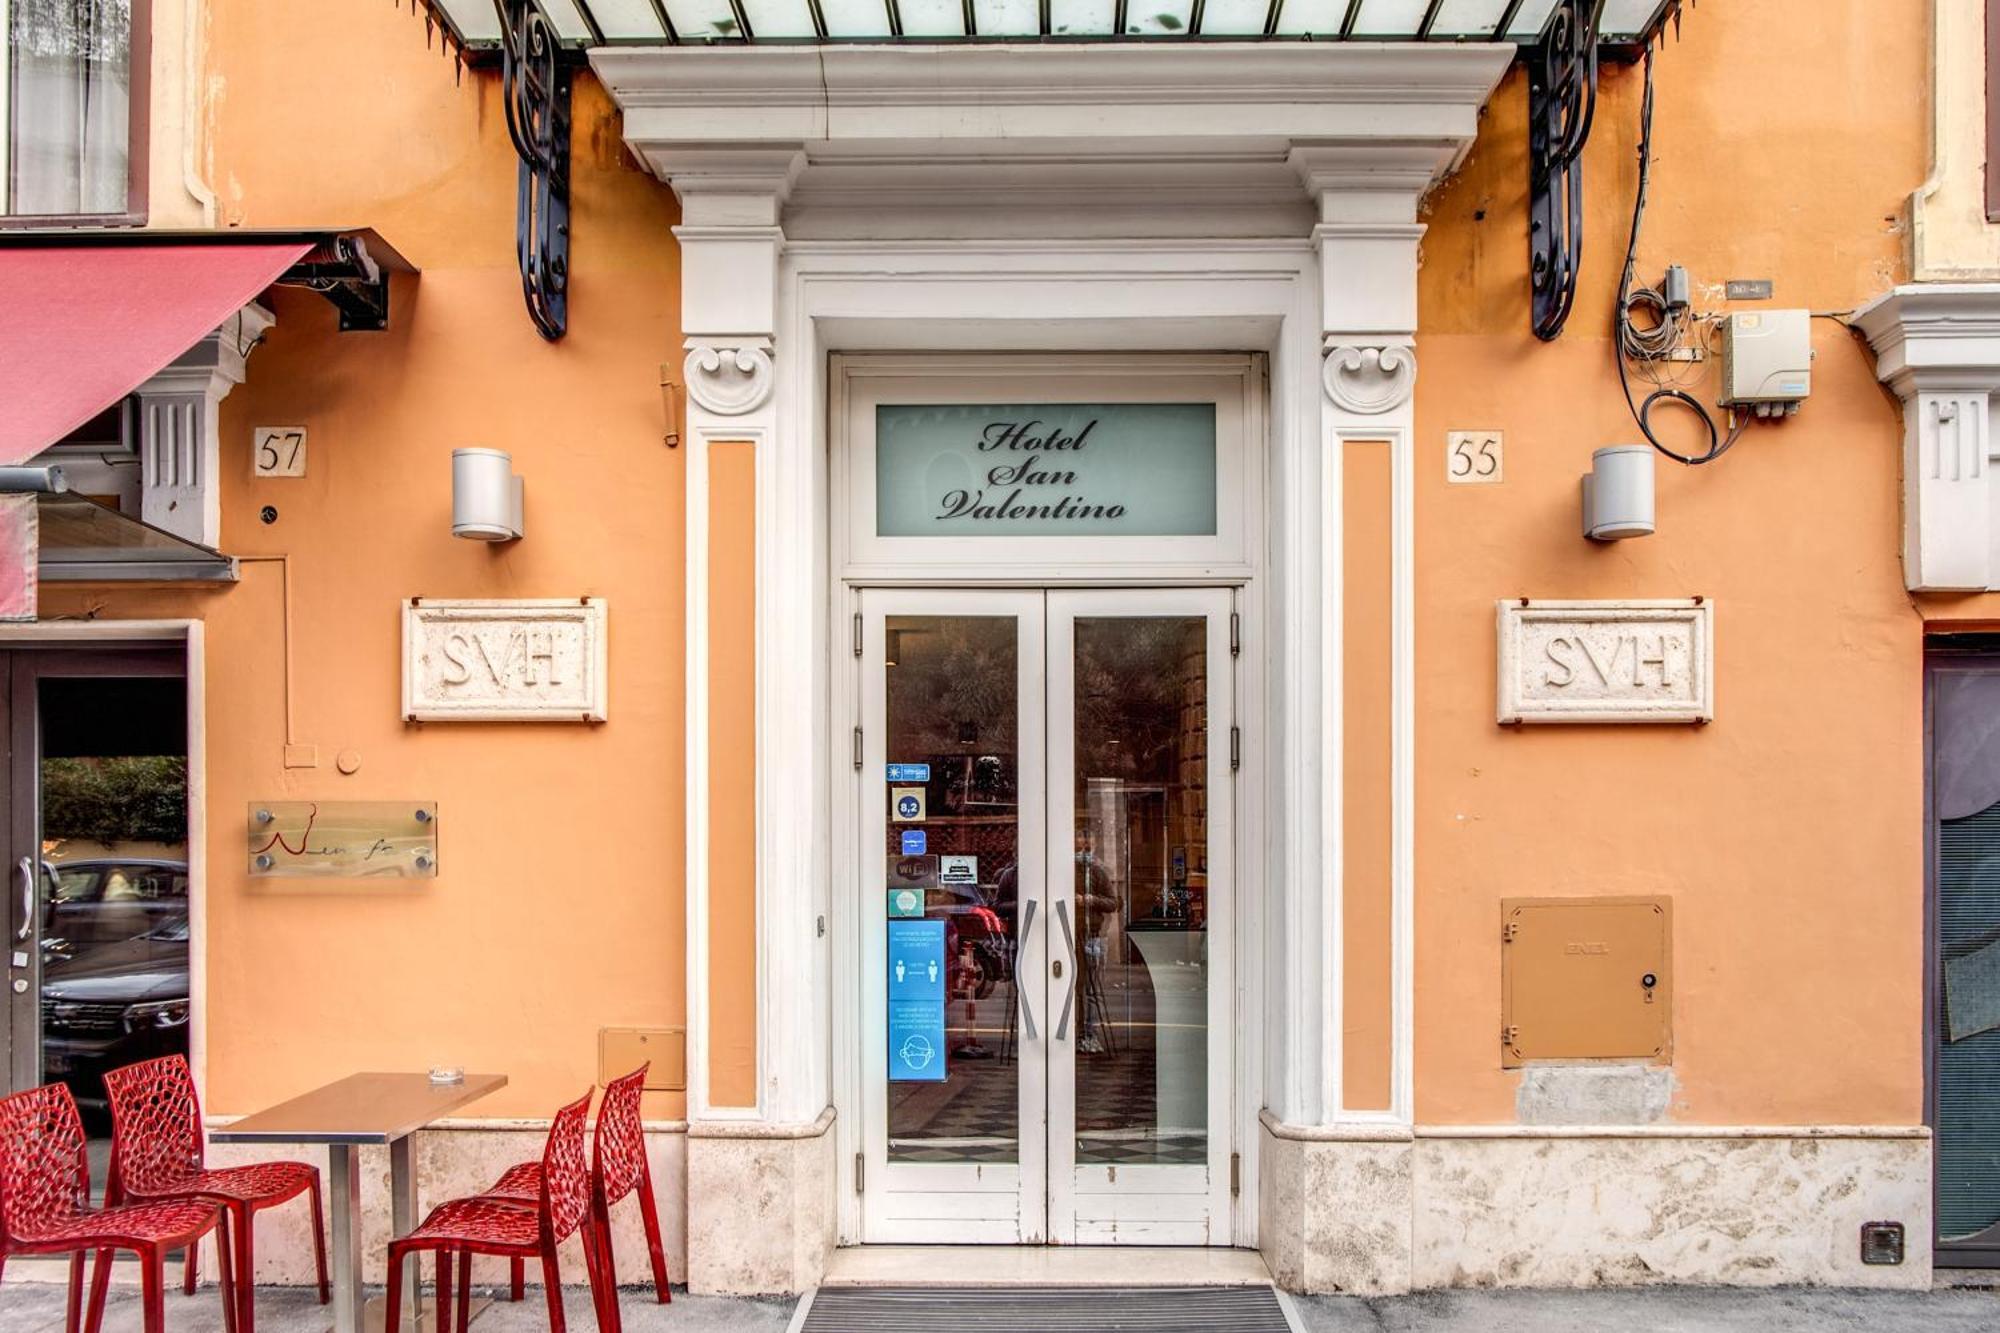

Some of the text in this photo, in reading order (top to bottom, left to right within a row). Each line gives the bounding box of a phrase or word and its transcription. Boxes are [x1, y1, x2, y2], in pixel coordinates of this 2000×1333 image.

[258, 433, 303, 470] 57
[977, 419, 1098, 451] Hotel
[987, 454, 1078, 489] San
[1451, 438, 1497, 477] 55
[935, 488, 1128, 520] Valentino
[442, 631, 563, 689] SVH
[1543, 635, 1672, 689] SVH
[900, 802, 918, 814] 8,2
